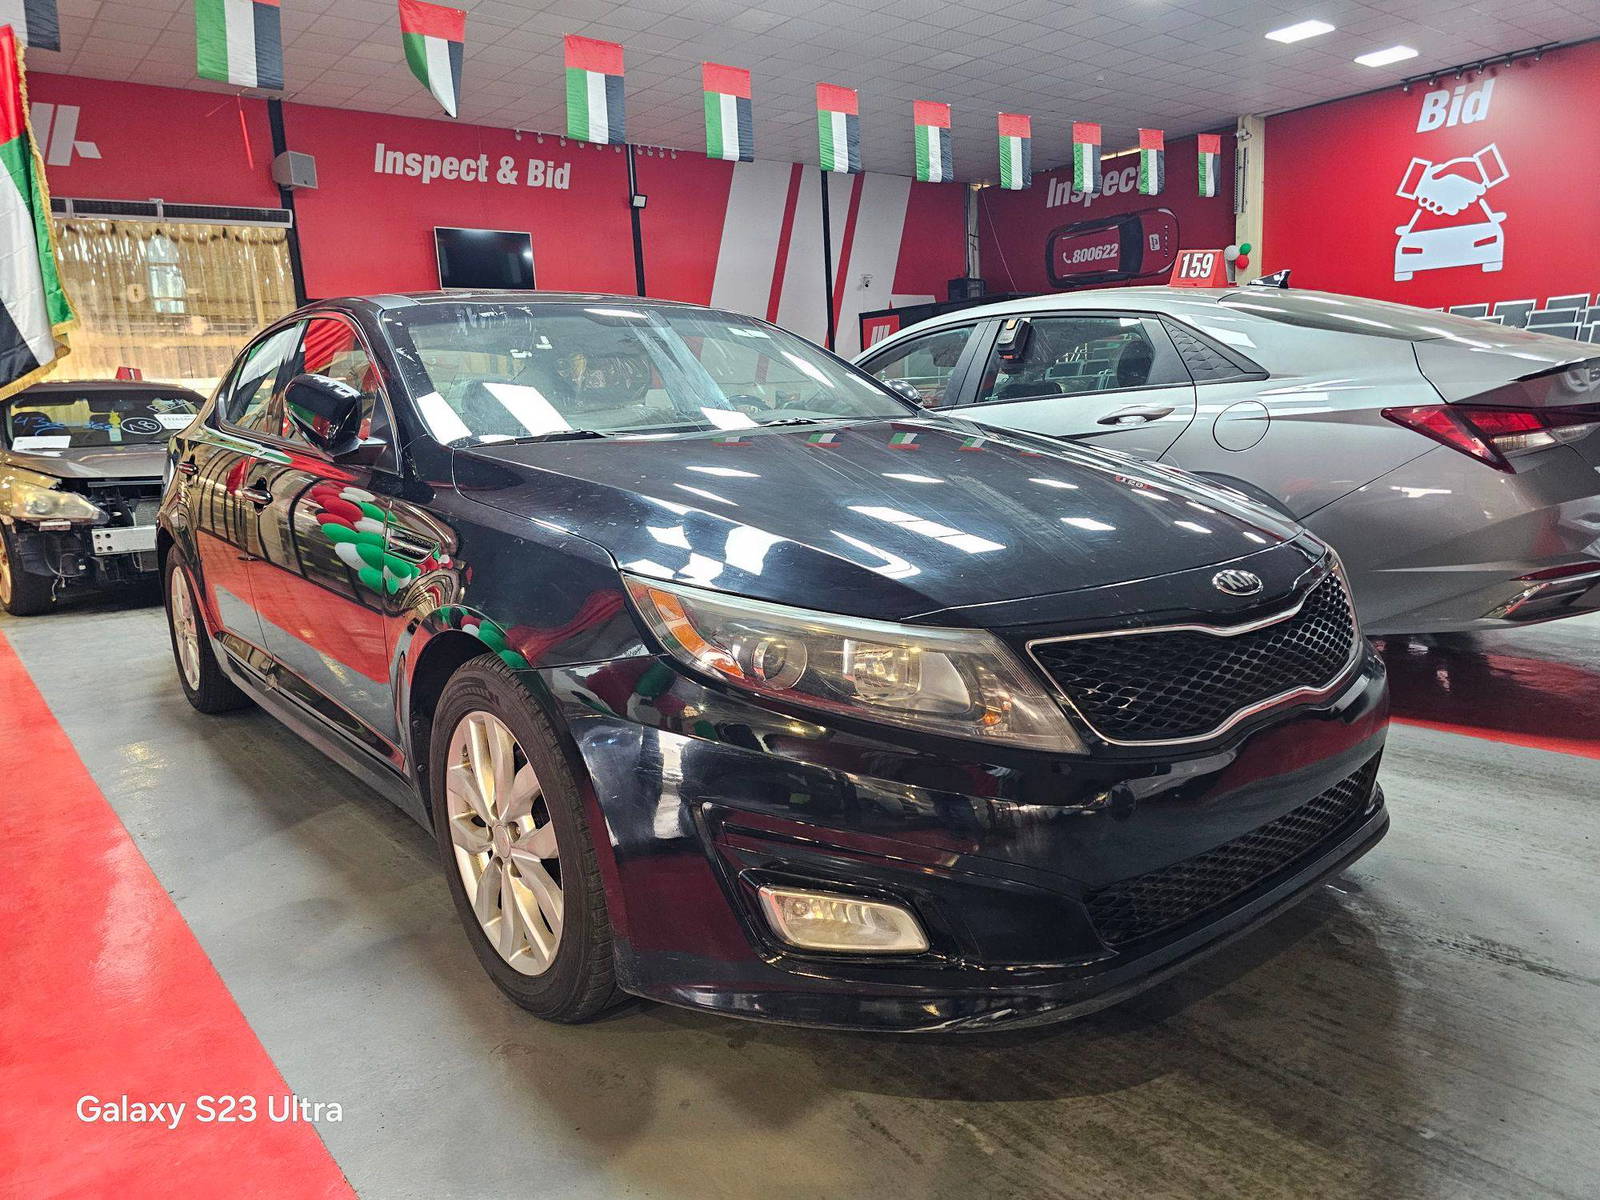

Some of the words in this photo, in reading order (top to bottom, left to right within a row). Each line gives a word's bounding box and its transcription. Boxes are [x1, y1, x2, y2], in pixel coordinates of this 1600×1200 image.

[1416, 78, 1496, 133] Bid
[374, 143, 489, 184] Inspect
[496, 156, 518, 185] &
[527, 158, 571, 190] Bid
[1072, 243, 1119, 263] 800622
[1180, 253, 1215, 278] 159
